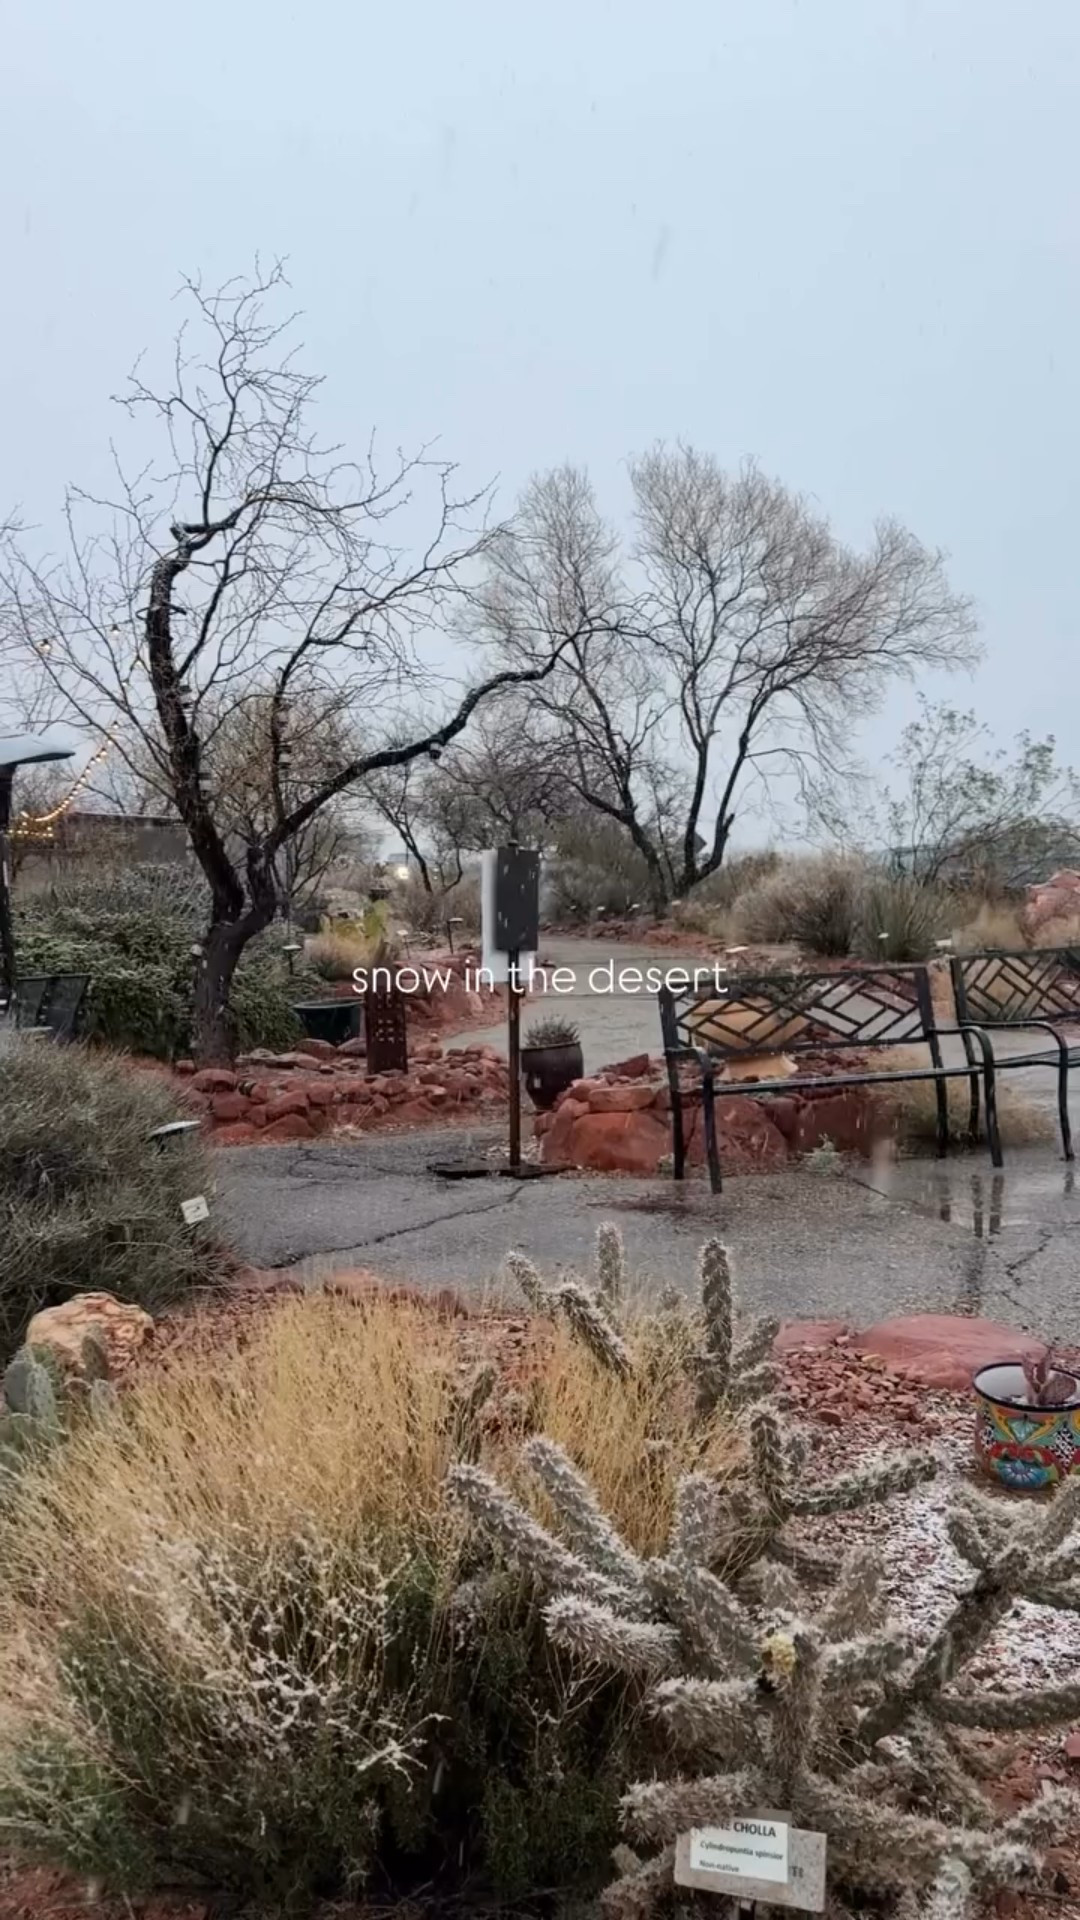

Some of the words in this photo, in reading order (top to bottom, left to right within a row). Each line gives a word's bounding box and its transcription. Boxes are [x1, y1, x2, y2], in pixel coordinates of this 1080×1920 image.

[733, 1821, 777, 1838] CHOLLA
[700, 1840, 754, 1856] Cylindropuntia
[699, 1859, 740, 1873] Non-native
